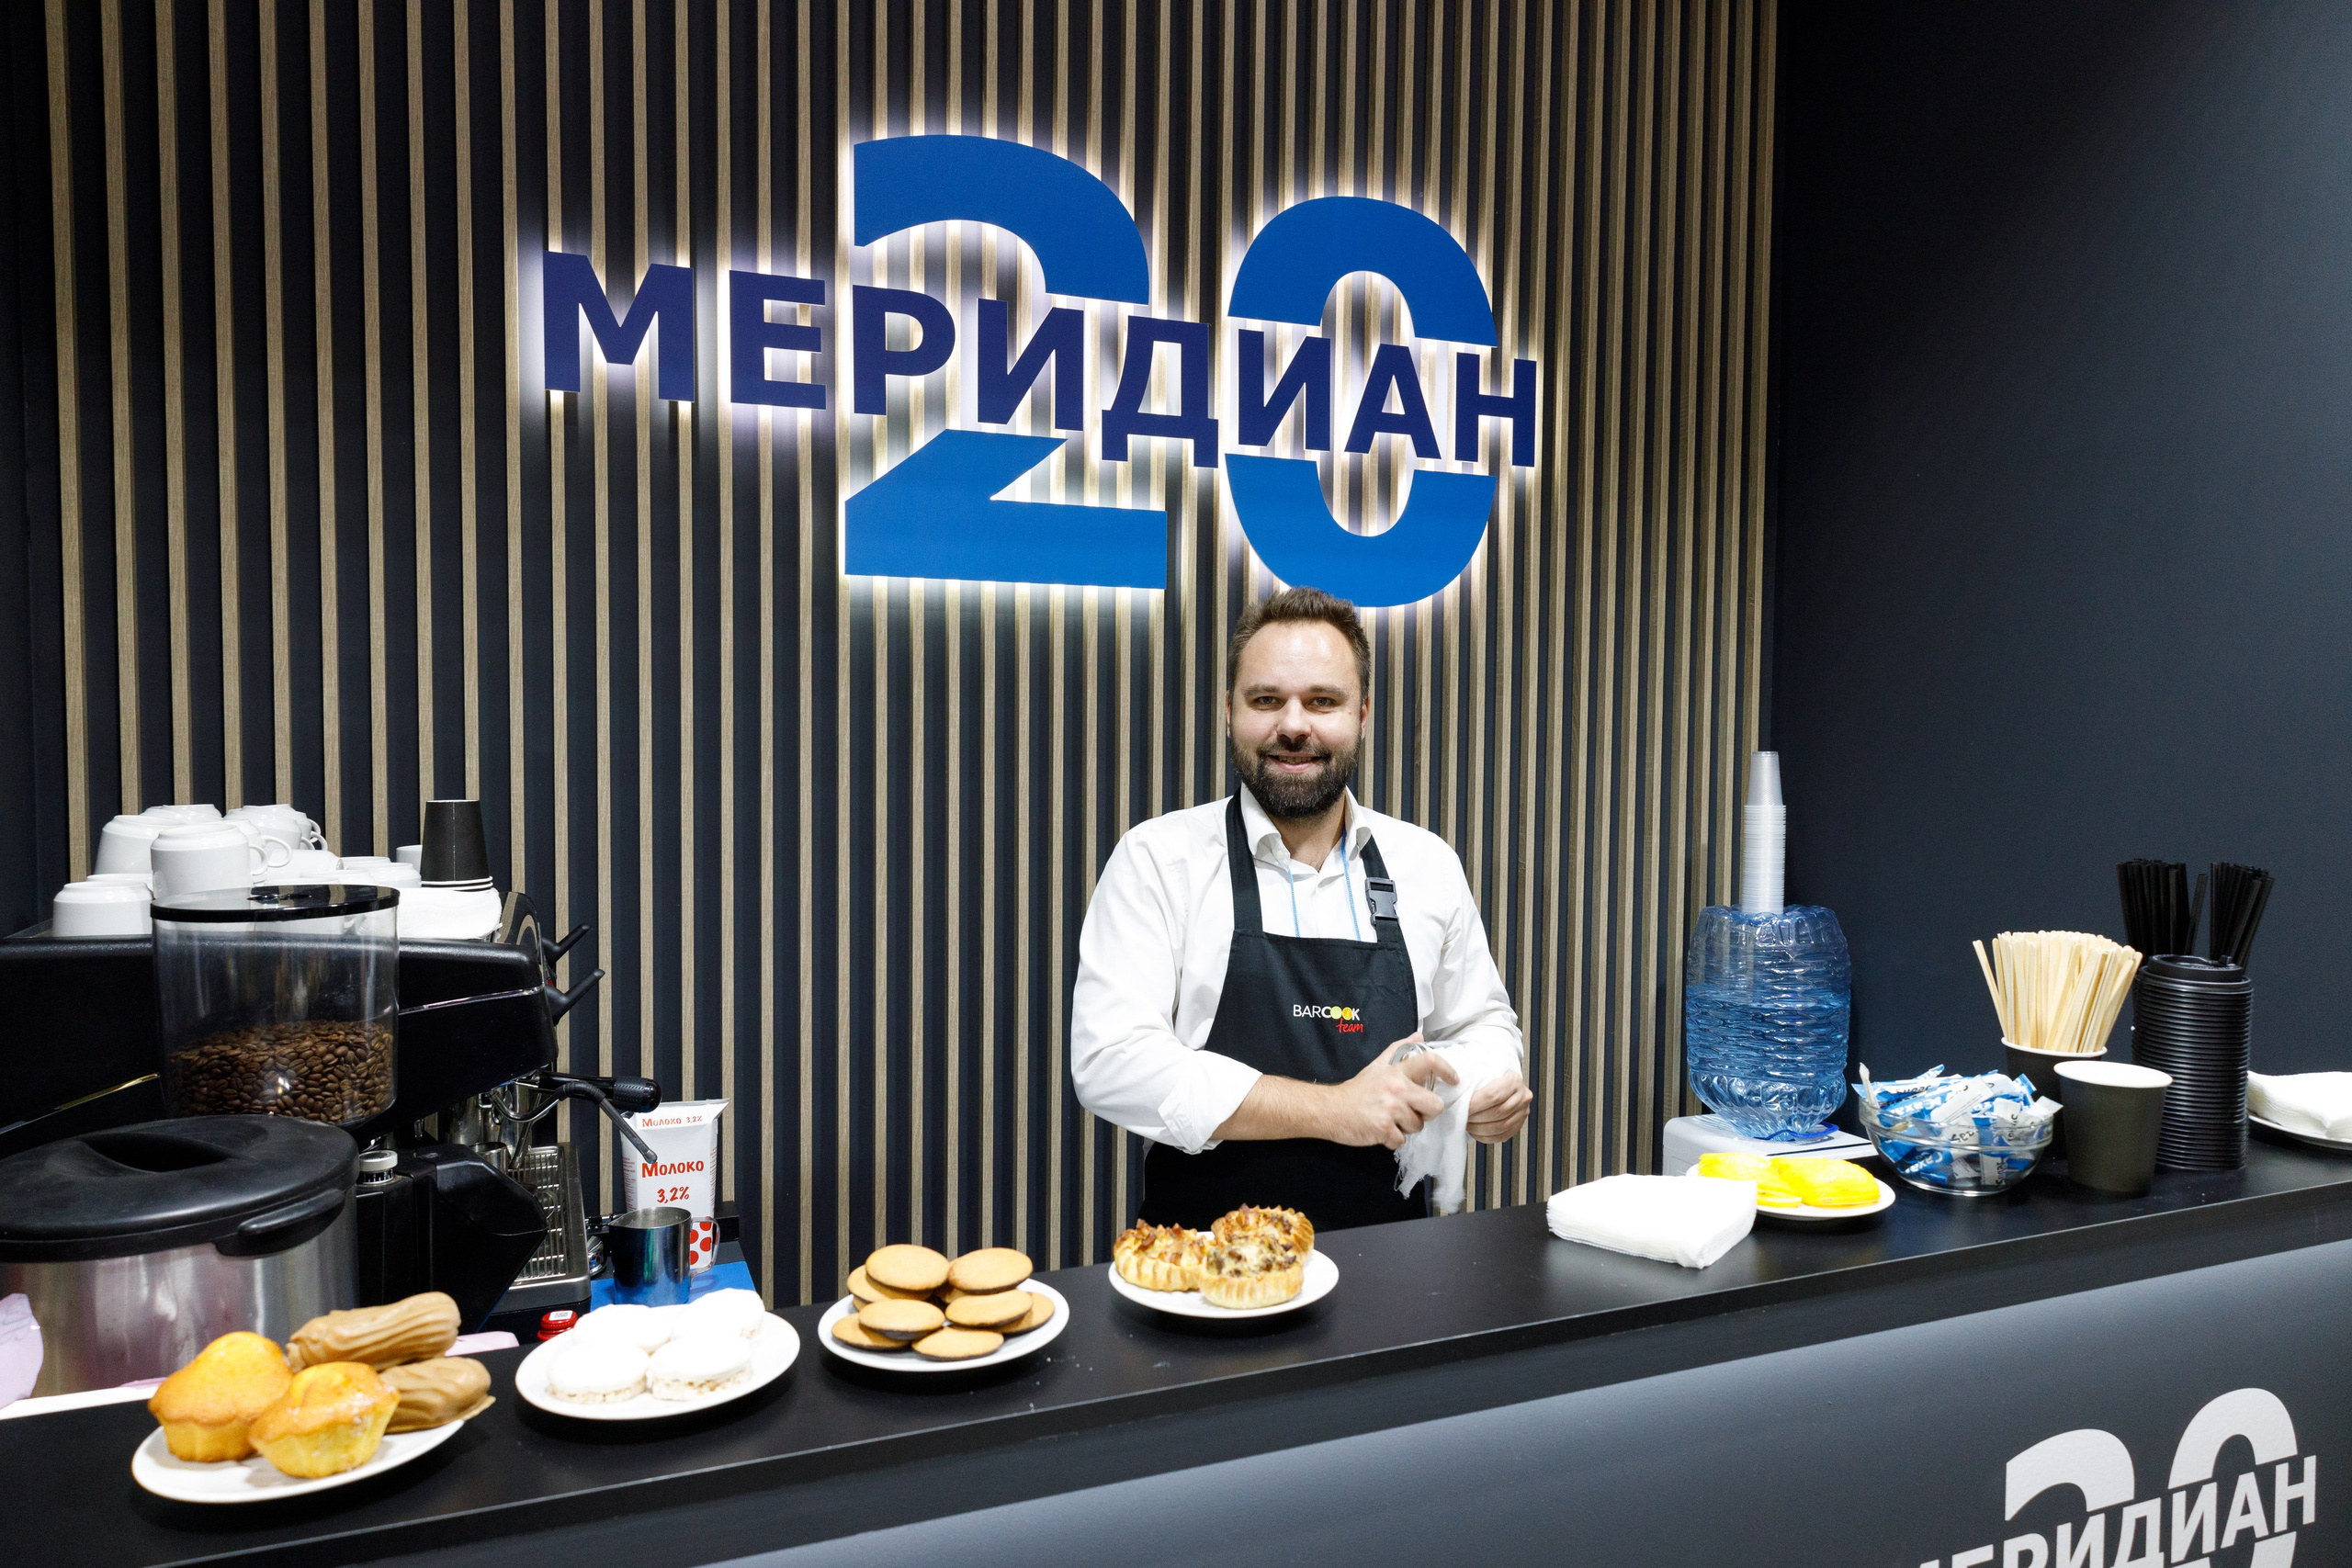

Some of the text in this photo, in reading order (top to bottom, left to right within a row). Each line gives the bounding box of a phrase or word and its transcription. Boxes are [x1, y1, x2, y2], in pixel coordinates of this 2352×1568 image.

[543, 250, 1537, 468] МЕРИДИАН
[1293, 1004, 1360, 1021] BARCOOK
[1336, 1018, 1363, 1033] team
[641, 1115, 703, 1128] Молоко 3,2%
[641, 1160, 705, 1179] Молоко
[657, 1186, 690, 1204] 3,2%
[1918, 1454, 2317, 1568] РИДИАН
